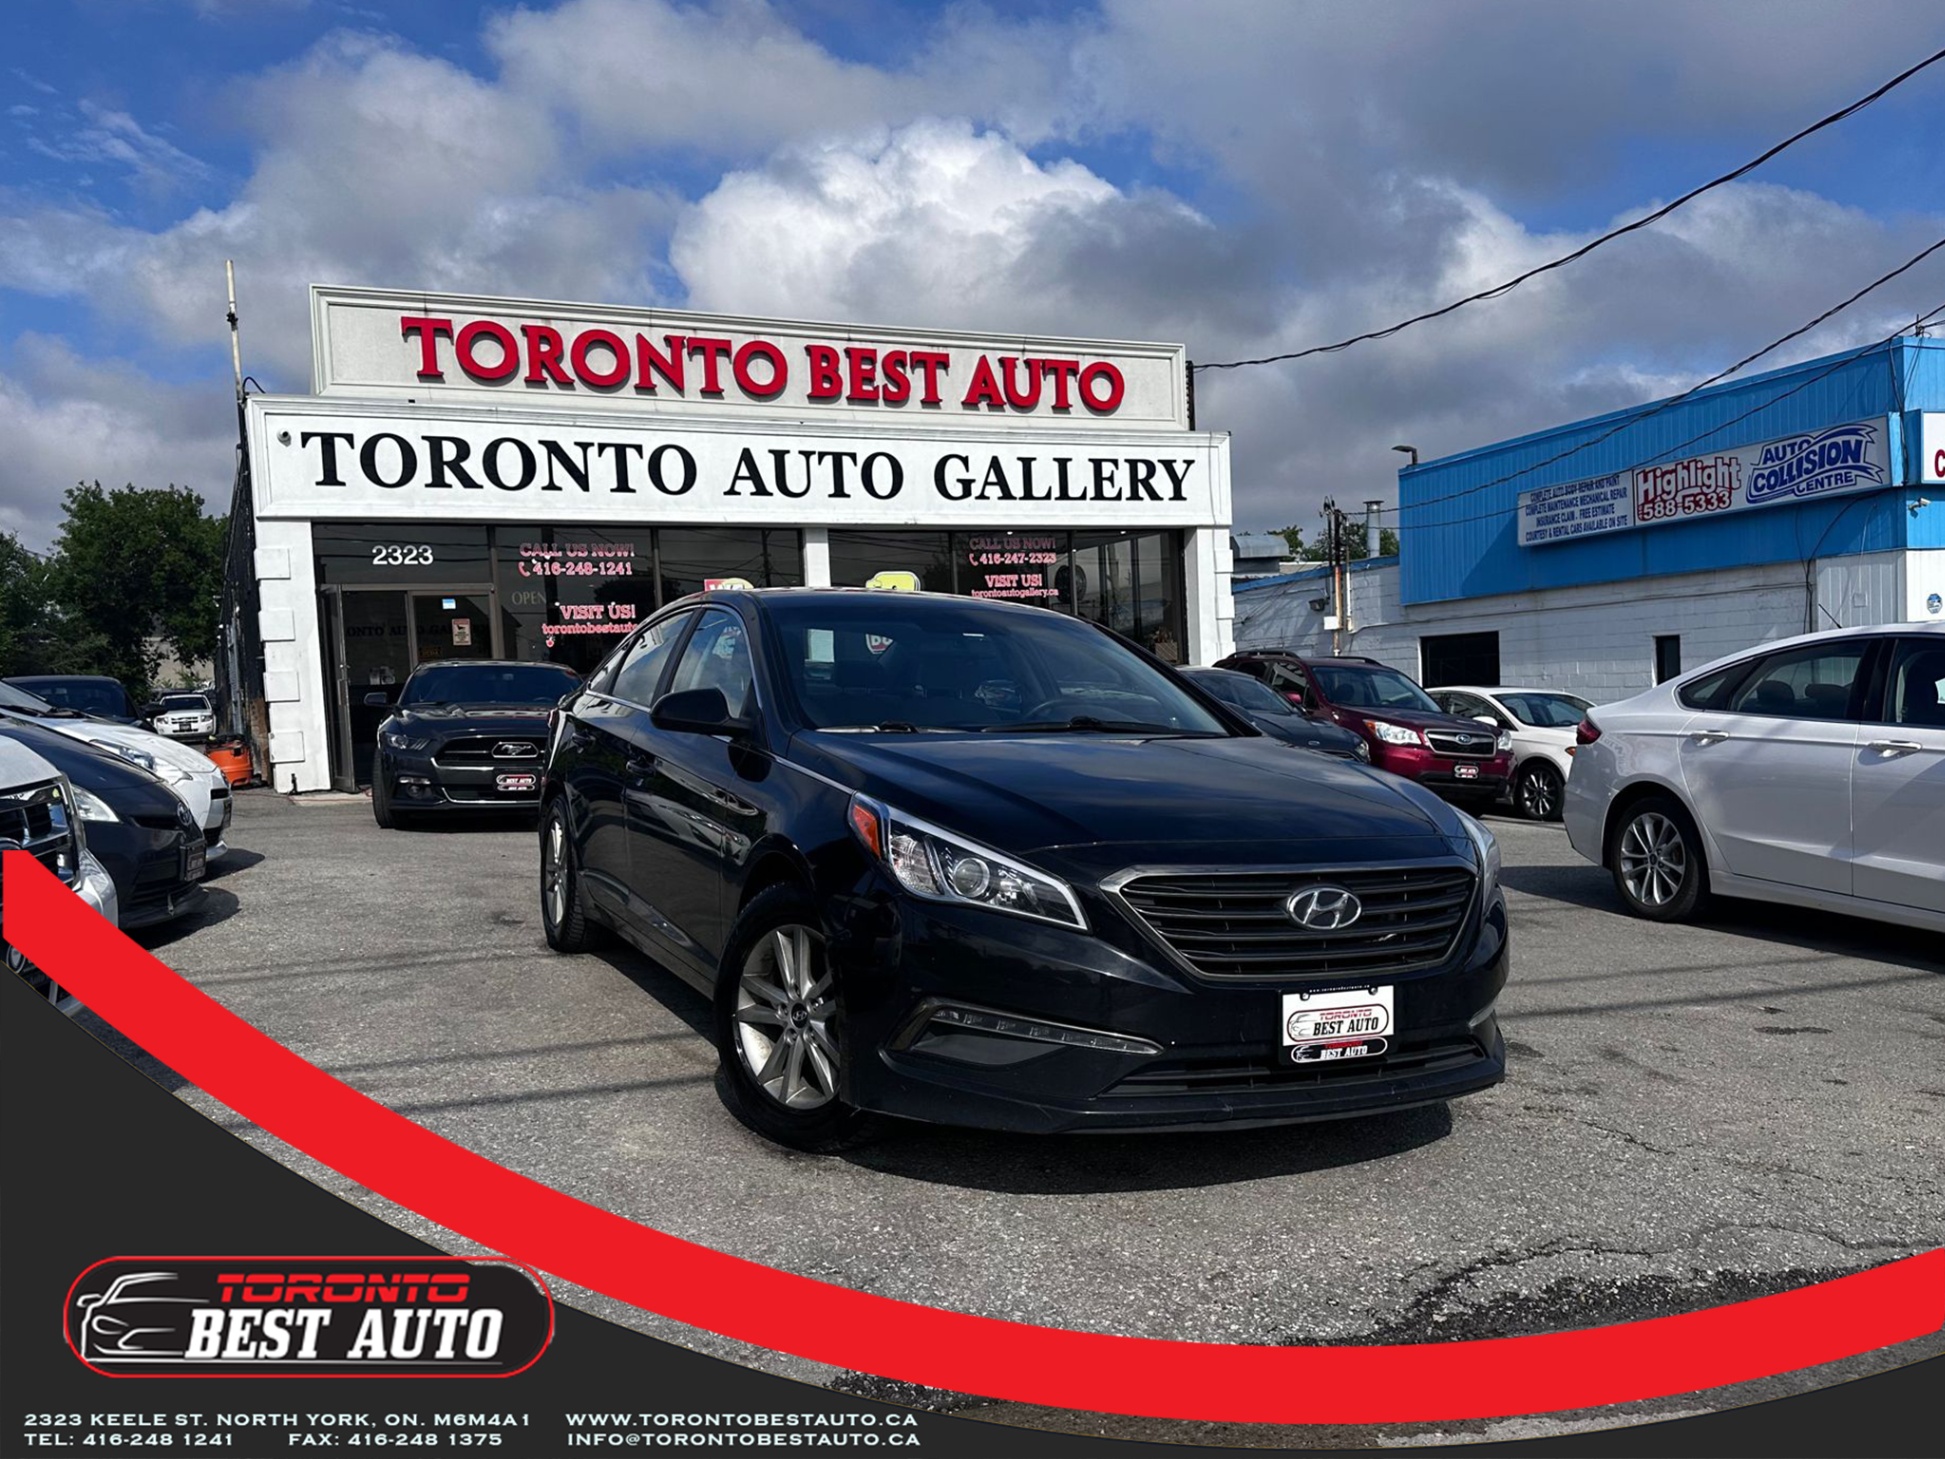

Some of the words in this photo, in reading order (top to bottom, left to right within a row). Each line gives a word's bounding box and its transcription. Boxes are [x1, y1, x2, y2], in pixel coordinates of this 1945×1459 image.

[402, 316, 788, 397] TORONTO
[805, 344, 950, 404] BEST
[962, 355, 1125, 411] AUTO
[301, 431, 697, 491] TORONTO
[723, 447, 904, 500] AUTO
[934, 453, 1195, 501] GALLERY
[1753, 439, 1864, 493] COLLISION
[1636, 456, 1741, 505] Highlight
[1796, 471, 1854, 494] CENTRE
[1525, 503, 1547, 517] COMPLETE
[1547, 497, 1579, 512] MAINTENANCE
[1579, 491, 1610, 506] MECHANICAL
[1610, 487, 1628, 500] REPAIR
[1643, 490, 1731, 520] 588-5333
[1579, 508, 1591, 519] FREE
[1592, 504, 1615, 518] ESTIMATE
[1553, 526, 1570, 538] RENTAL
[1570, 523, 1583, 535] CARS
[1609, 518, 1616, 529] ON
[1617, 515, 1628, 526] SITE
[519, 543, 562, 557] CALL
[565, 543, 588, 557] US
[591, 543, 635, 557] NOW!
[969, 538, 1001, 550] CALL
[1003, 538, 1021, 550] US
[1023, 538, 1056, 550] NOW!
[372, 544, 434, 565] 2323
[979, 553, 1057, 565] 416-247-2323
[532, 562, 633, 576] 416-248-1241
[985, 574, 1019, 588] VISIT
[1021, 574, 1043, 587] US!
[511, 592, 547, 605] OPEN
[559, 605, 604, 620] VISIT
[608, 604, 636, 619] US!
[1319, 1009, 1373, 1021] TORONTO
[1312, 1020, 1344, 1036] BEST
[1346, 1018, 1379, 1033] AUTO
[1320, 1048, 1343, 1060] BEST
[1344, 1046, 1368, 1057] AUTO
